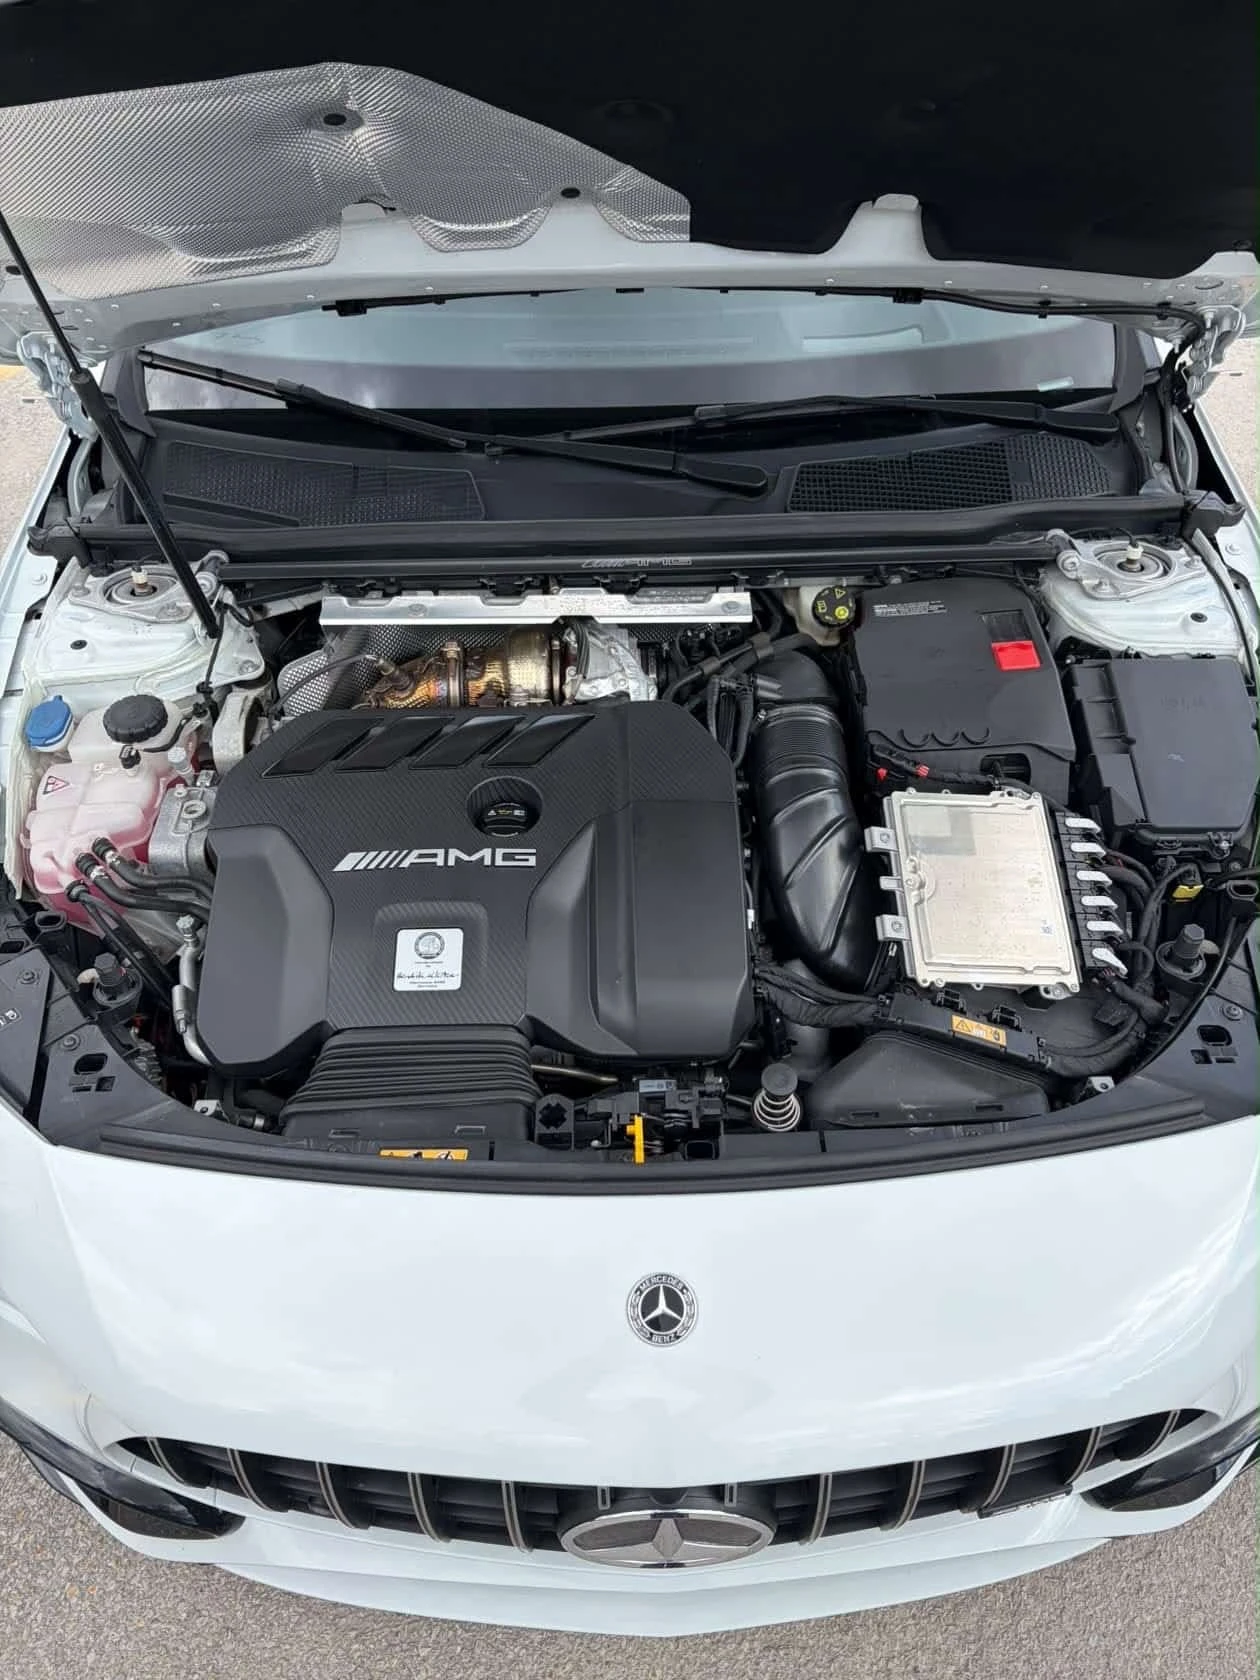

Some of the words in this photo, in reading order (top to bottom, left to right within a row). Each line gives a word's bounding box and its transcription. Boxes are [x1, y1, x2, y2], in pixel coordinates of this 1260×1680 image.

[400, 848, 537, 868] AMG
[640, 1276, 683, 1290] MERCEDES
[652, 1335, 677, 1343] BENZ
